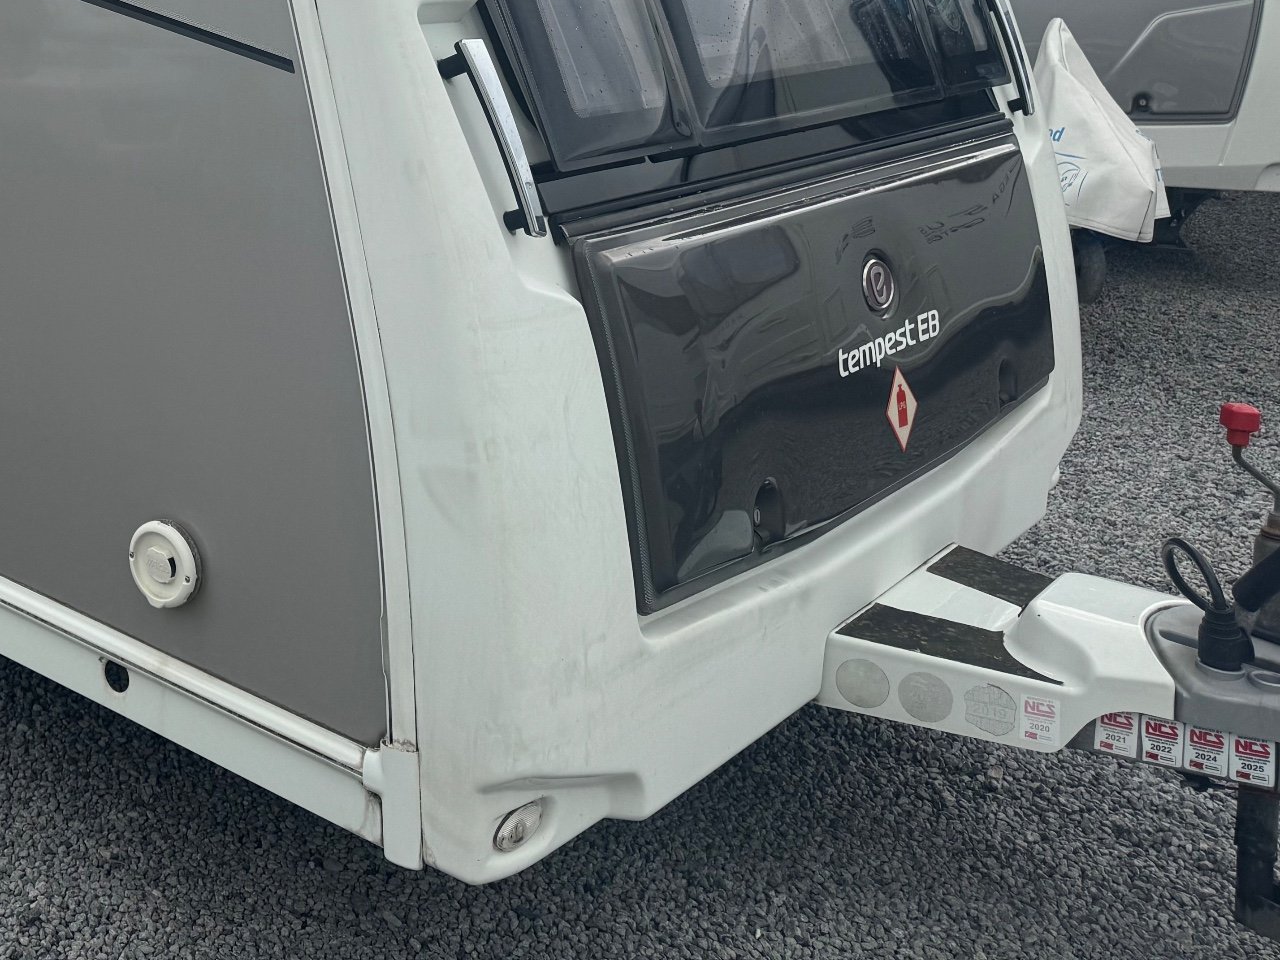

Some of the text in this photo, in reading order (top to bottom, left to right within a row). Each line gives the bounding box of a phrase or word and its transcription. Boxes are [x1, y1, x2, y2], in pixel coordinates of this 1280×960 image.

[838, 309, 940, 378] tempest EB
[1024, 700, 1056, 718] NCS
[1029, 722, 1050, 733] 2020
[1145, 721, 1178, 740] NCS
[1105, 733, 1126, 744] 2021
[1189, 728, 1224, 750] NCS
[1150, 743, 1173, 754] 2022
[1235, 739, 1270, 759] NCS
[1195, 751, 1218, 763] 2024
[1240, 762, 1265, 773] 2025
